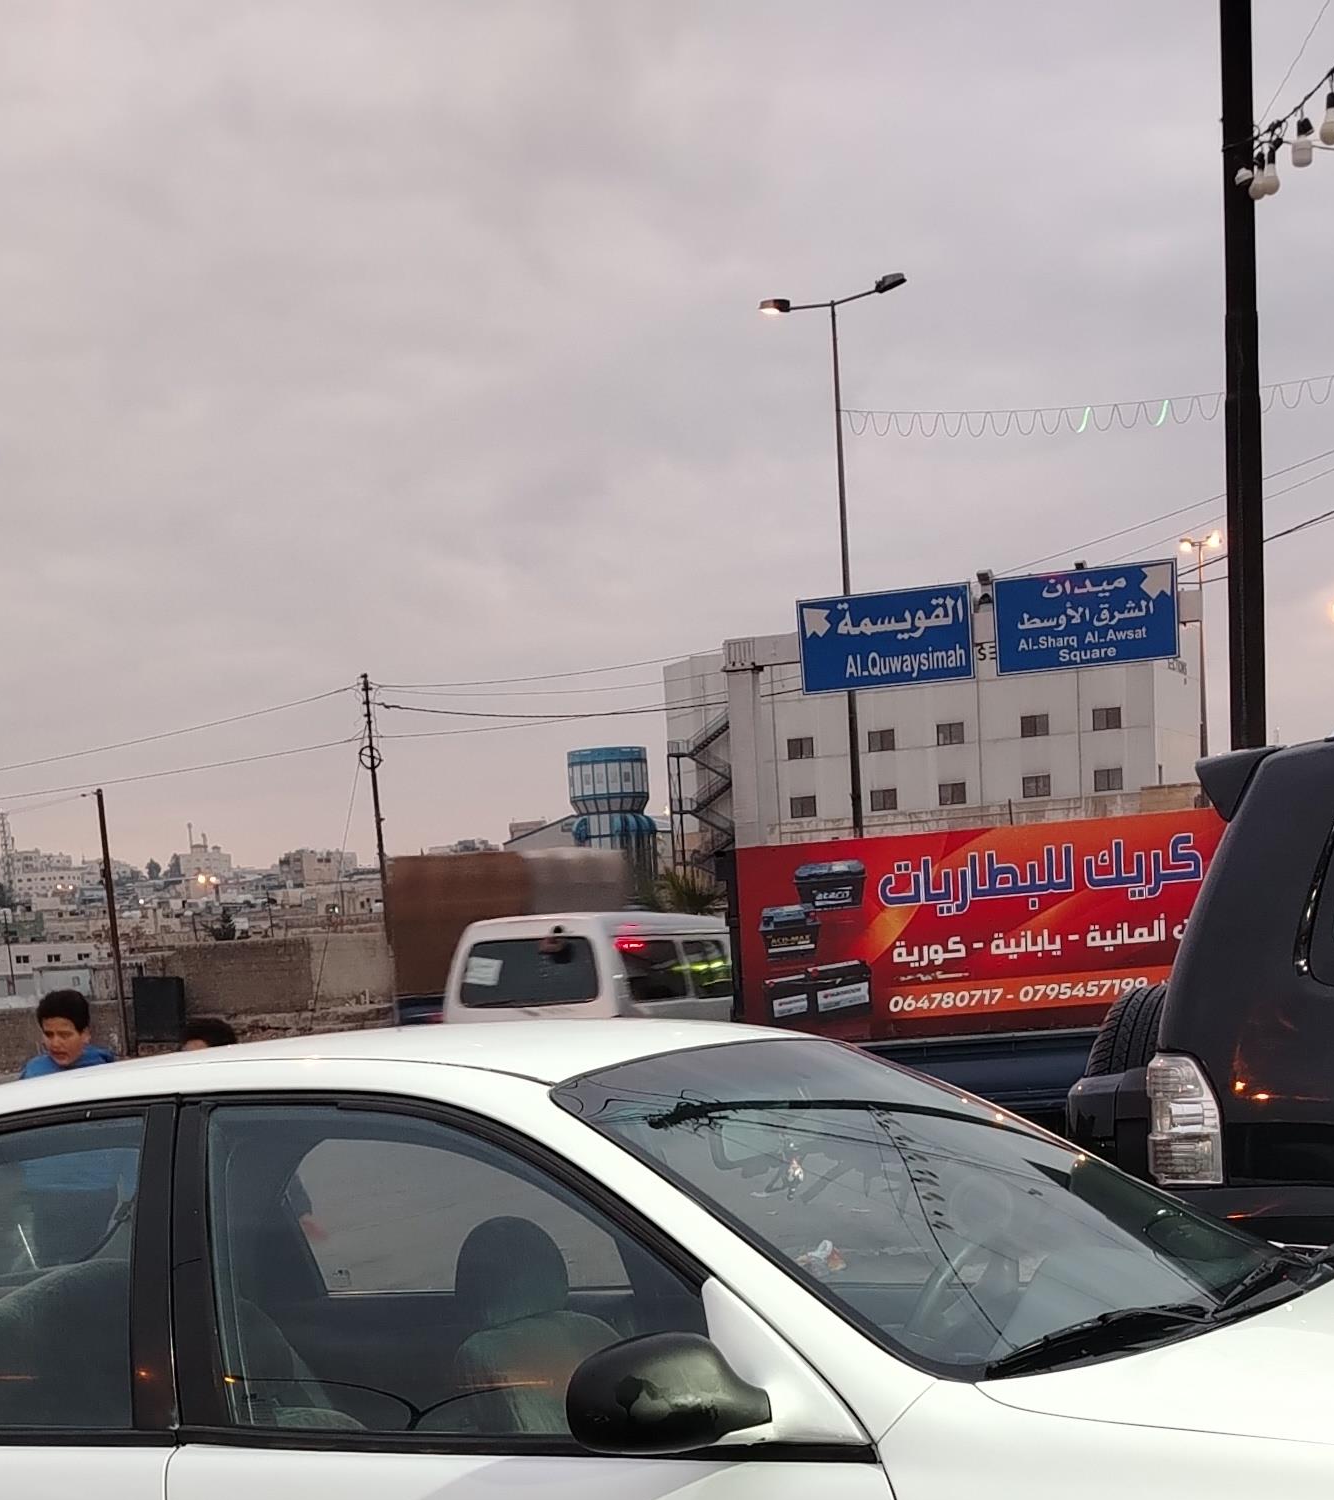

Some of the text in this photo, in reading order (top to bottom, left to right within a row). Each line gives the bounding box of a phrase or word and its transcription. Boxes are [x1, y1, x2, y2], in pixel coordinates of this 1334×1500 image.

[1041, 576, 1127, 598] ميدان
[836, 594, 964, 640] القويسمة
[1017, 599, 1154, 631] الشرق الأوسط
[1058, 645, 1117, 663] Square
[878, 832, 1203, 917] كريك للبطاريات
[990, 928, 1062, 960] يابانية
[1086, 913, 1166, 951] ألمانية
[892, 936, 967, 967] كورية
[888, 987, 1004, 1013] 064780717
